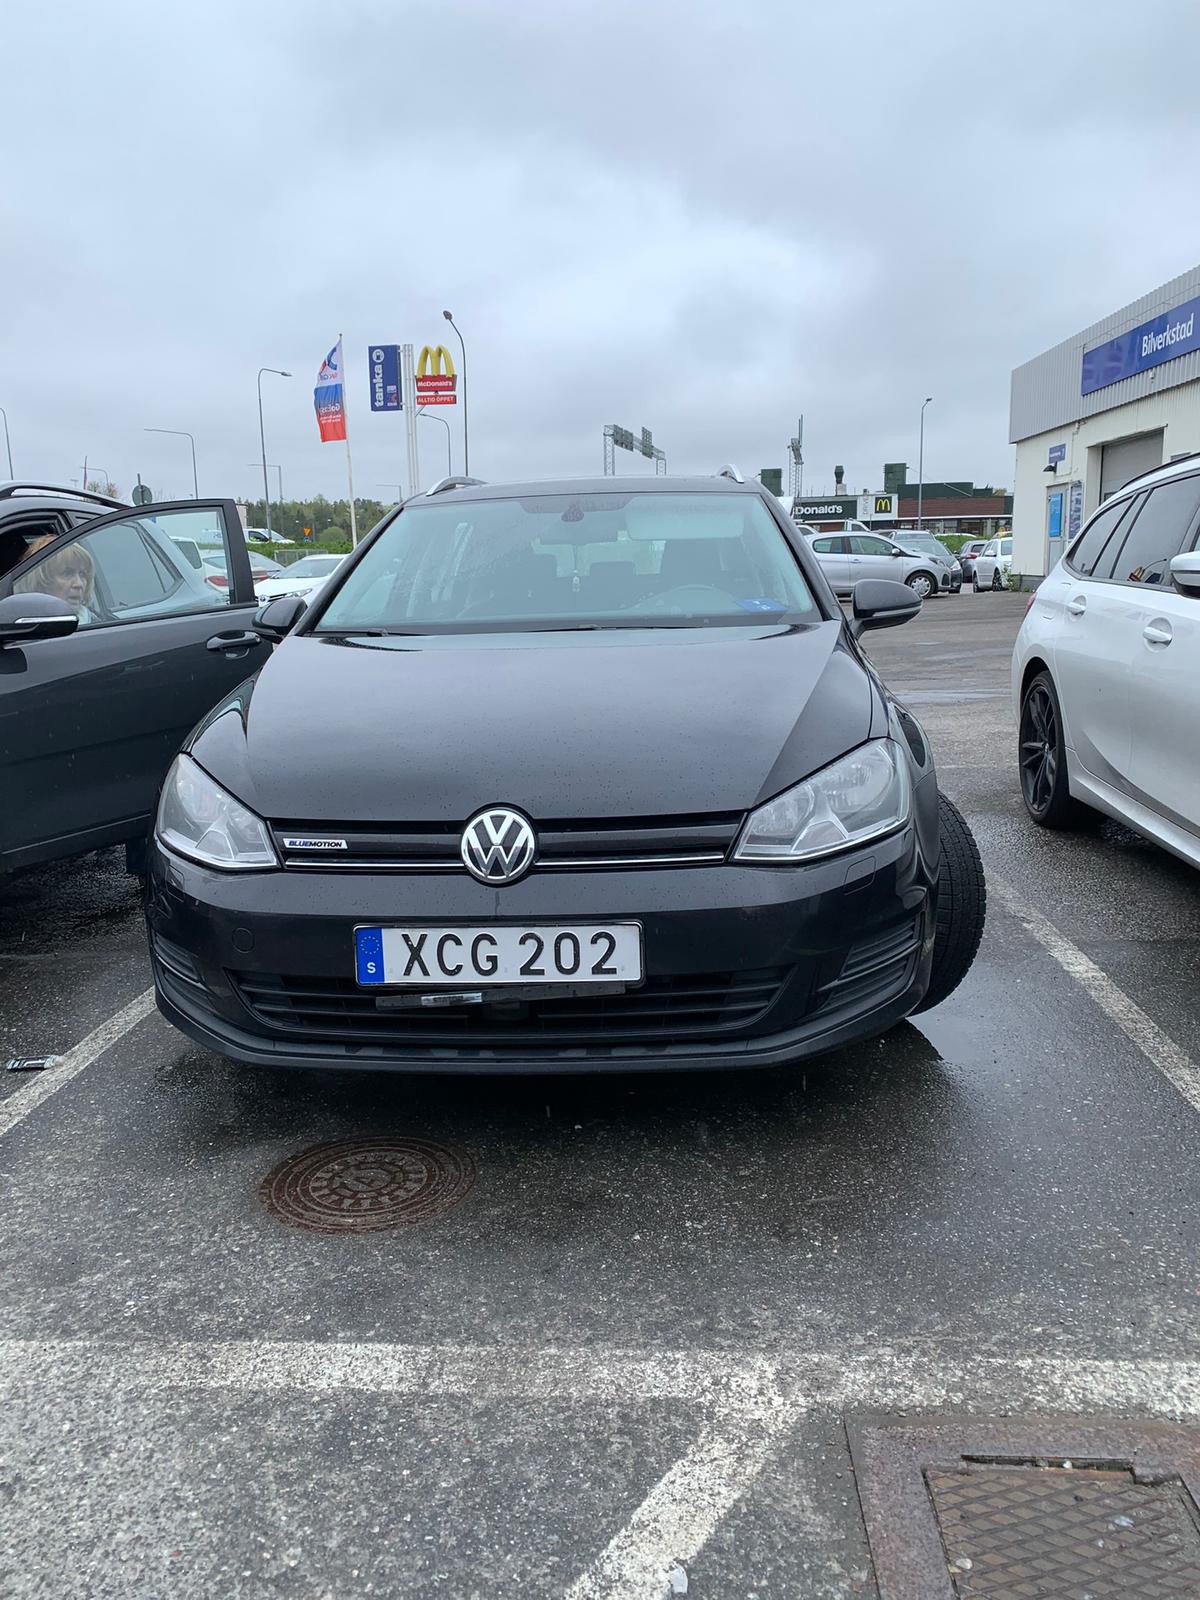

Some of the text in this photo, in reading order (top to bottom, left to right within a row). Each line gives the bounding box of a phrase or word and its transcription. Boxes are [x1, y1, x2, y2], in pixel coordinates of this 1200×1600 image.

[1141, 312, 1194, 357] Bilverkstad
[373, 364, 384, 407] tanka
[794, 505, 843, 515] Donald's
[288, 840, 342, 848] BLUEMOTION
[367, 962, 376, 973] S
[401, 931, 618, 977] XCG 202
